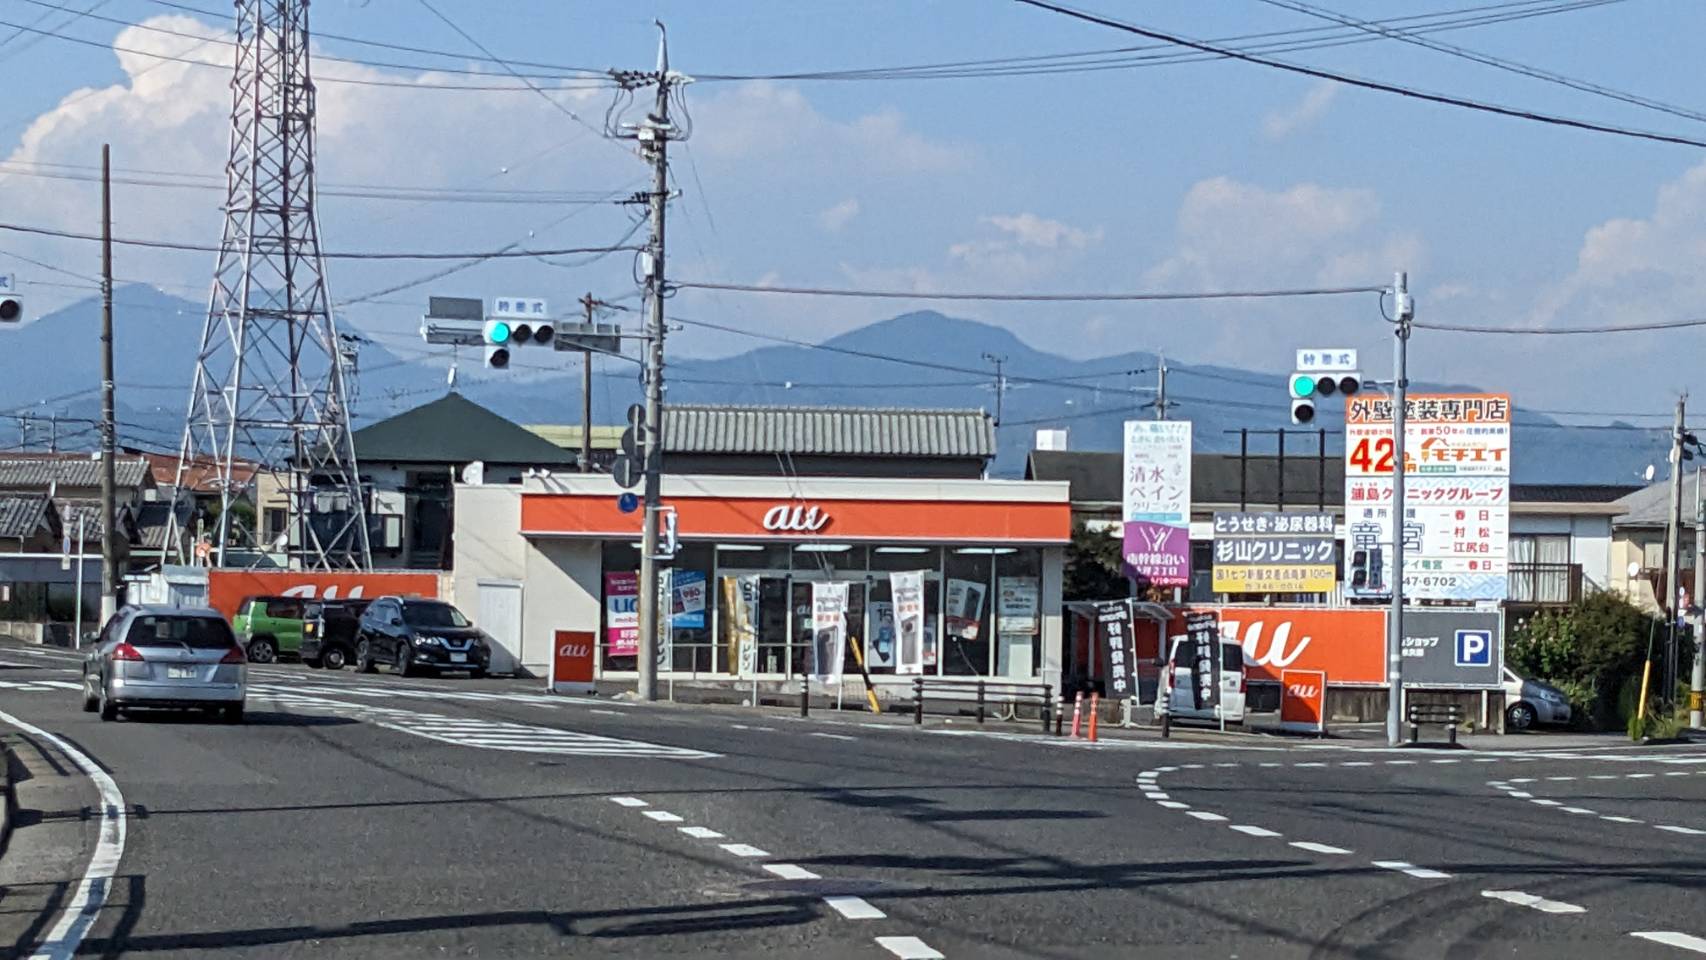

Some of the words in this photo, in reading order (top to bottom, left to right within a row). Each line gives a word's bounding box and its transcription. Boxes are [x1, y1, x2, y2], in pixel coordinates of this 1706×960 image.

[1130, 466, 1165, 482] 清水
[1351, 487, 1503, 501] 浦島クニックグループ
[763, 505, 829, 530] au
[1363, 508, 1416, 518] 通所護
[1216, 540, 1332, 561] 杉山クリニック
[1454, 542, 1489, 553] 江尻台
[559, 644, 590, 657] au
[1463, 634, 1484, 662] P
[1288, 684, 1319, 698] au
